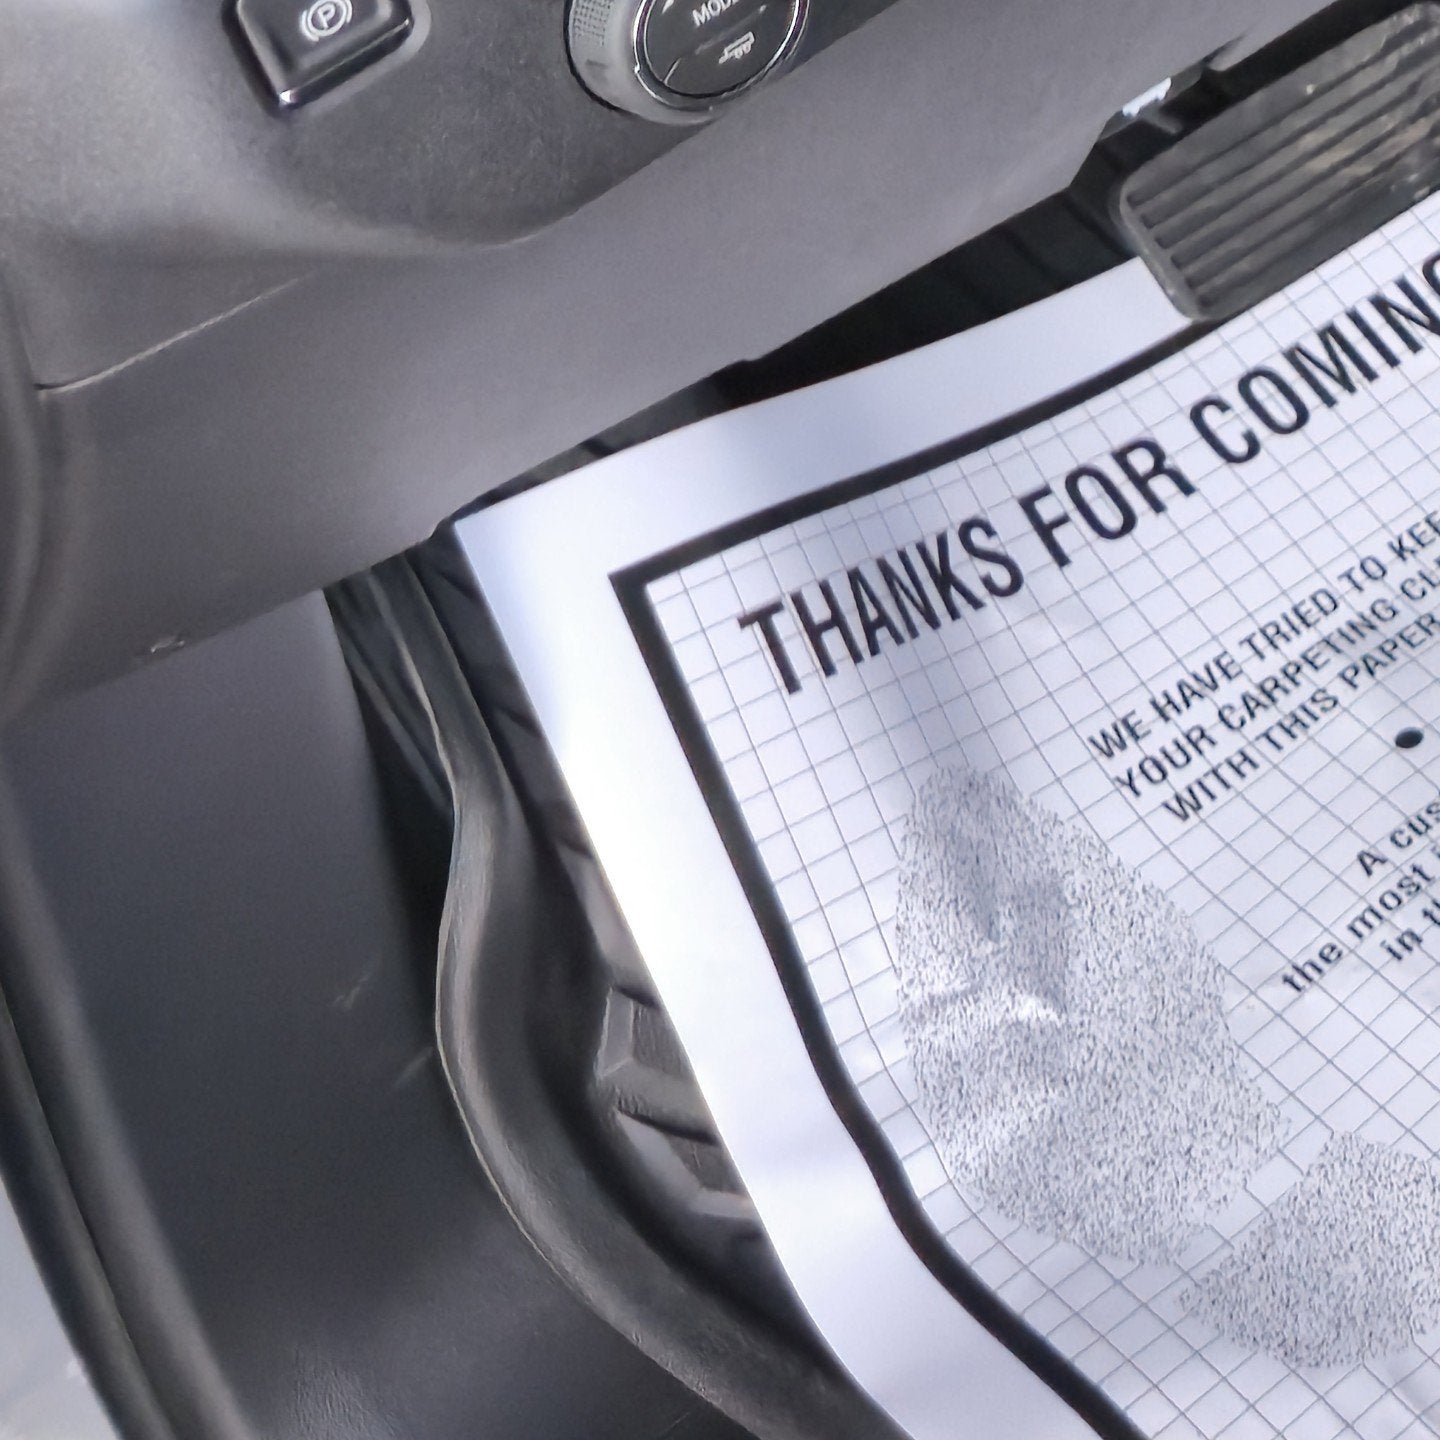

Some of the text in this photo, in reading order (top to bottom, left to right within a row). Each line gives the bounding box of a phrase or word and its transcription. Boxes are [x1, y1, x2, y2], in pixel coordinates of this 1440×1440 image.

[738, 516, 1025, 694] THANKS
[1017, 436, 1199, 569] FOR
[1088, 708, 1154, 761] WE
[1149, 649, 1245, 723] HAVE
[1241, 586, 1340, 663] TRIED
[1340, 555, 1389, 598] TO
[1113, 722, 1217, 801] YOUR
[1216, 598, 1400, 732] CARPETING
[1161, 746, 1260, 825] WITH
[1259, 689, 1341, 756] THIS
[1280, 939, 1345, 995] the
[1345, 865, 1438, 944] most
[1354, 848, 1388, 879] A
[1381, 926, 1425, 964] in
